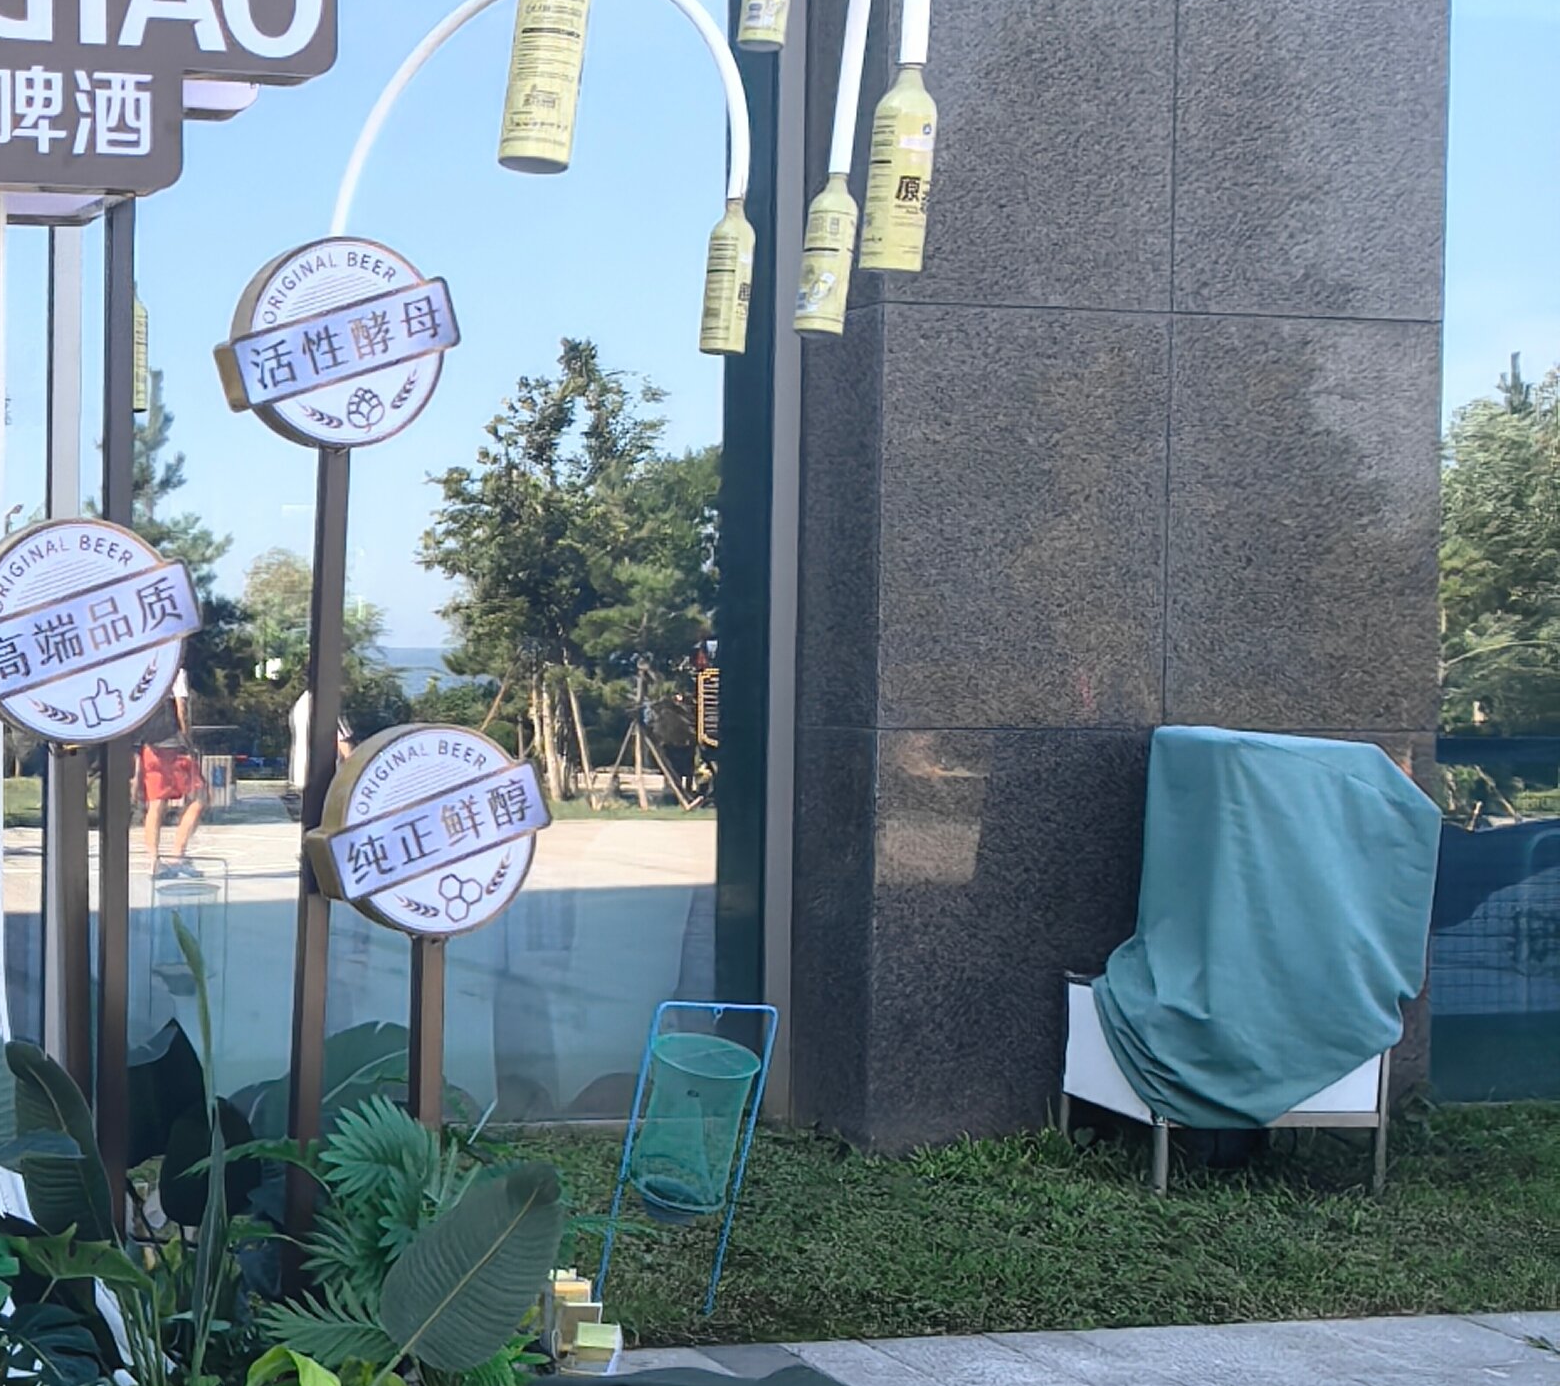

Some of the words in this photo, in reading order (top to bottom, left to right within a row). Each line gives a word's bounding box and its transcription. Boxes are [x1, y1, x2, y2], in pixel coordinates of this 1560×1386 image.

[262, 252, 337, 325] ORIGINAL
[347, 251, 397, 284] BEER
[251, 295, 441, 390] 活性酵母
[79, 534, 134, 566] BEER
[355, 741, 429, 816] ORIGINAL
[438, 739, 488, 771] BEER
[347, 778, 534, 885] 纯正鲜醇
